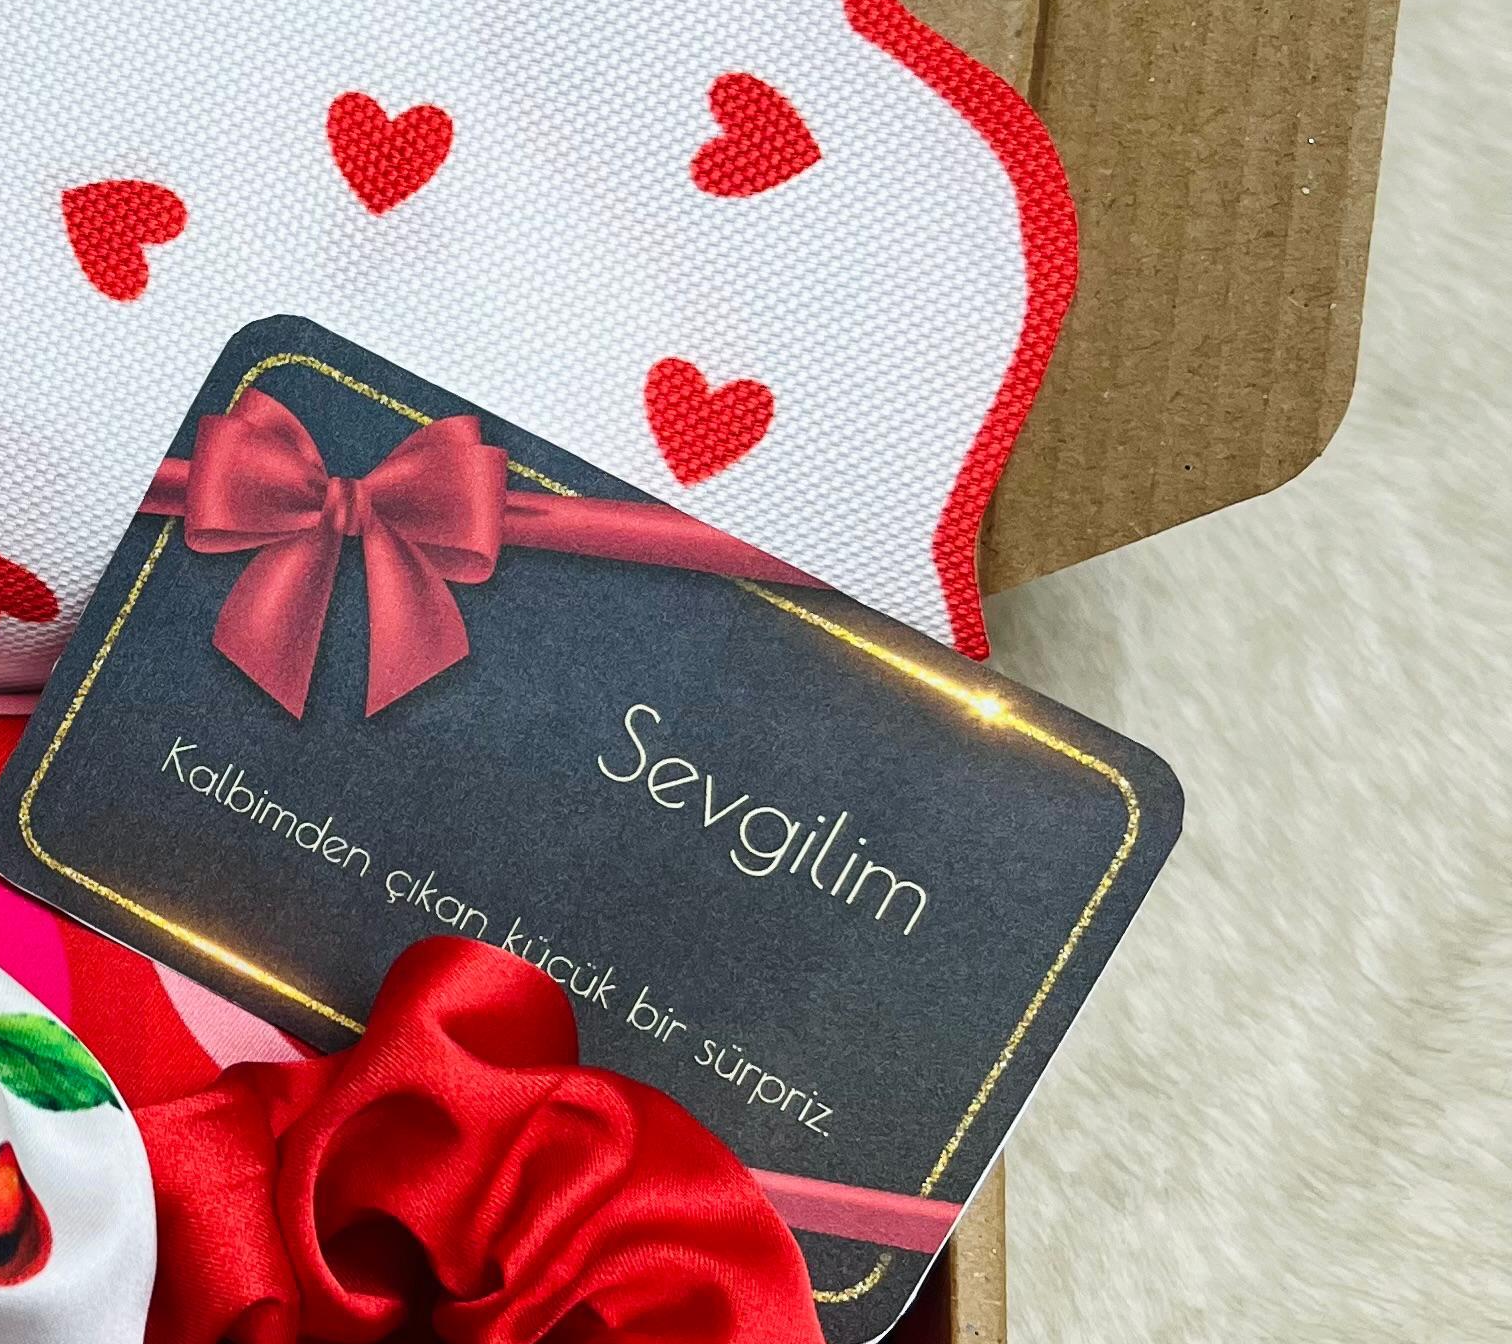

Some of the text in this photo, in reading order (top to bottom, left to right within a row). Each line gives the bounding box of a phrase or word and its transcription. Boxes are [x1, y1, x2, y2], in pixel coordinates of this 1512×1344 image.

[160, 736, 371, 878] Kalbimden
[385, 870, 488, 939] çıkan
[626, 985, 687, 1043] bir
[693, 1039, 834, 1138] sürpriz.
[597, 703, 927, 936] Sevgilim
